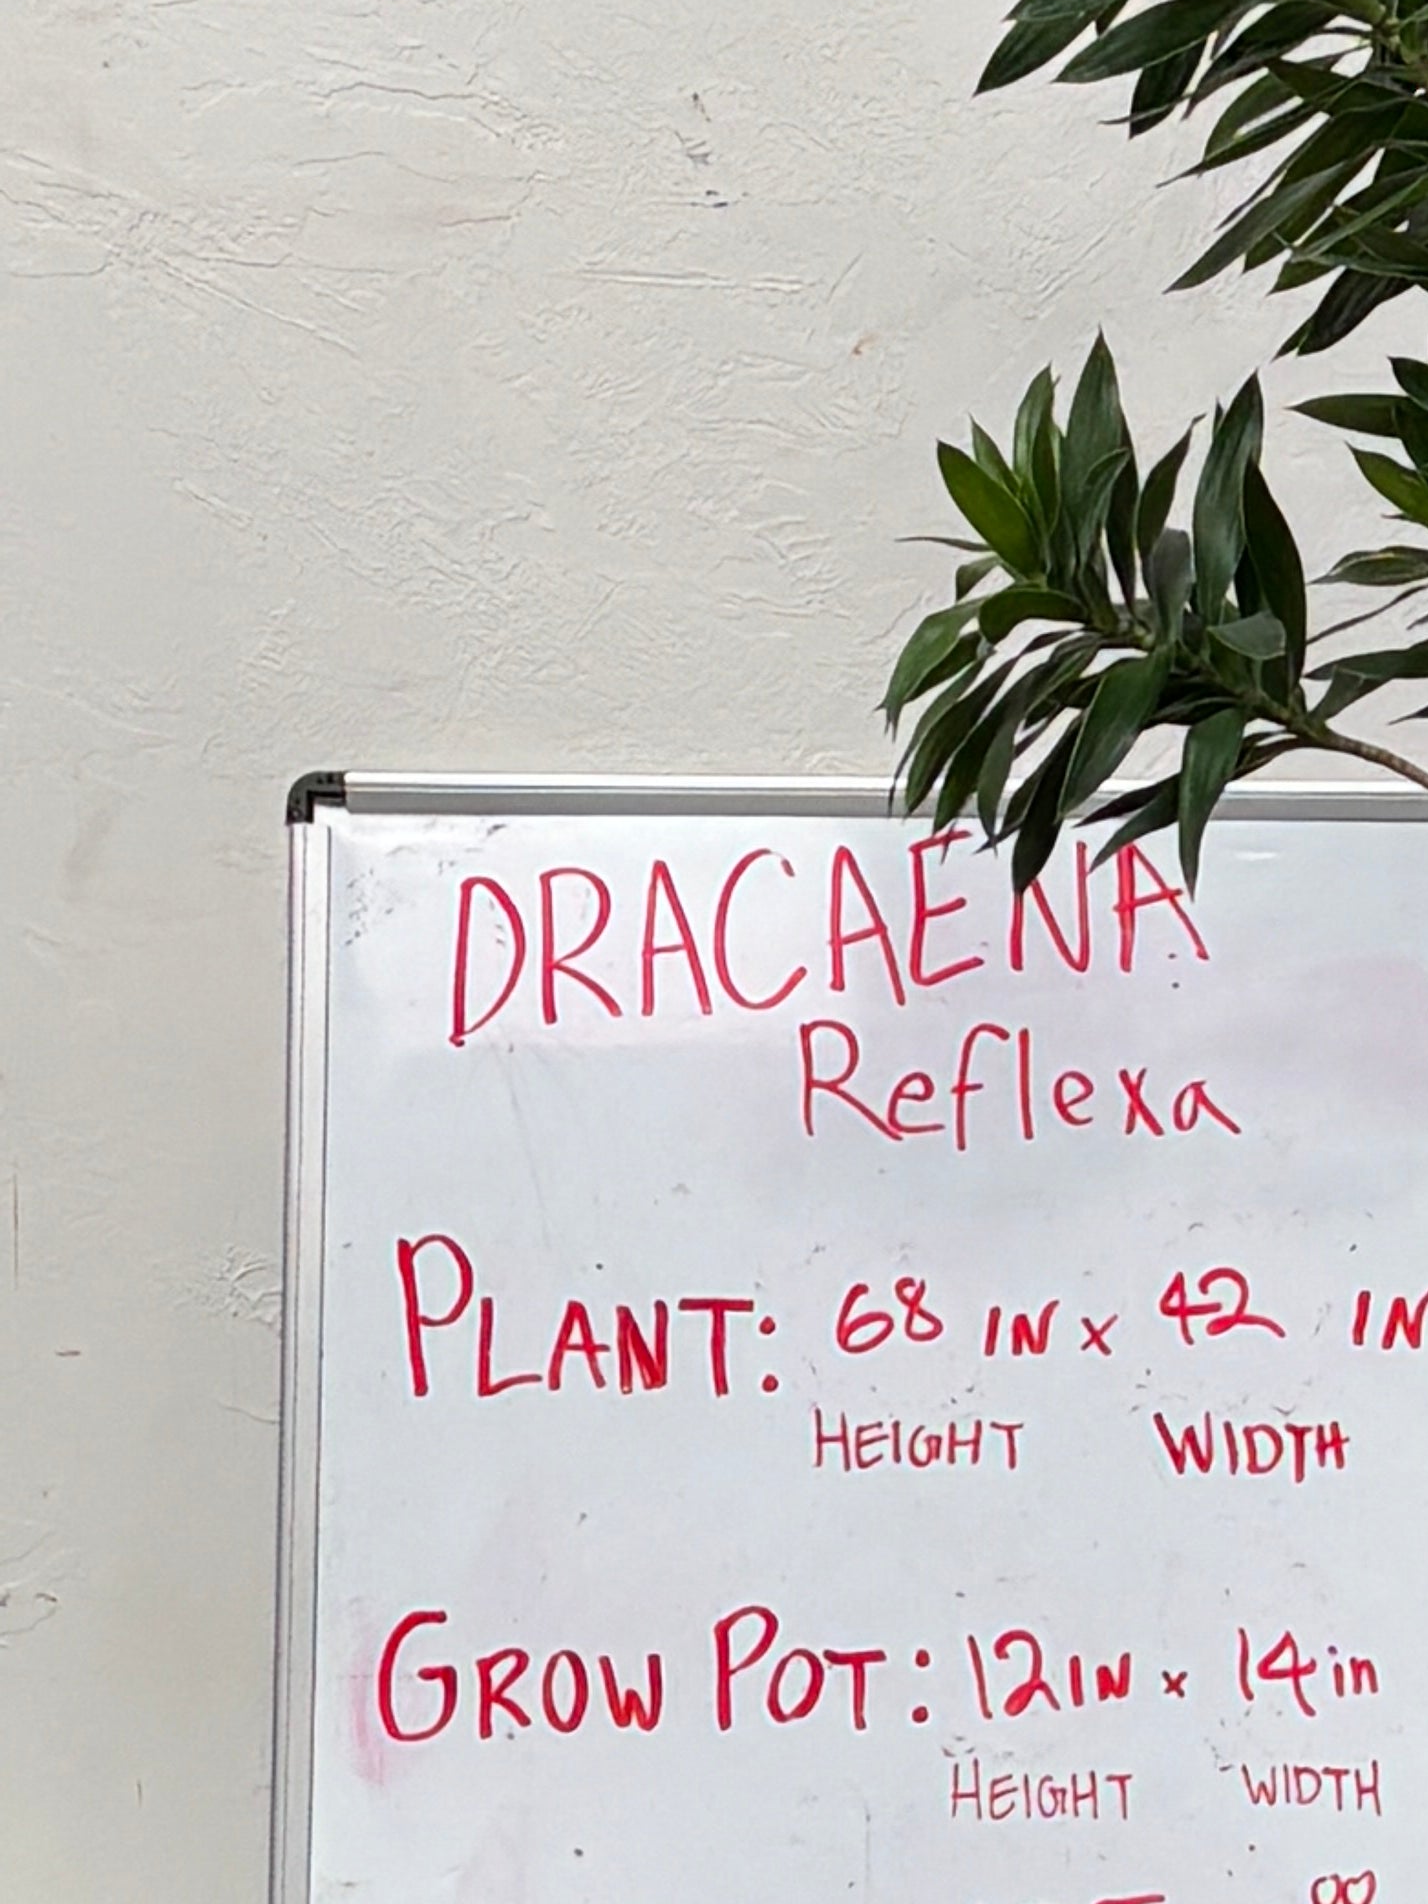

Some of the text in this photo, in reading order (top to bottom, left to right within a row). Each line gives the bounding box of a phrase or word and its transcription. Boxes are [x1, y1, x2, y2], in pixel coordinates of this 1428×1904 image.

[448, 829, 1209, 1048] DRACAENA
[798, 1018, 1239, 1151] Reflexa
[395, 1234, 779, 1399] PLANT:
[834, 1275, 944, 1356] 68
[982, 1300, 1058, 1357] IN
[1157, 1266, 1285, 1346] 42
[812, 1412, 1350, 1484] HEIGHT WIDTH
[375, 1609, 664, 1744] GROW
[711, 1605, 931, 1731] POT:
[949, 1760, 1382, 1822] HEIGHT WIDTH
